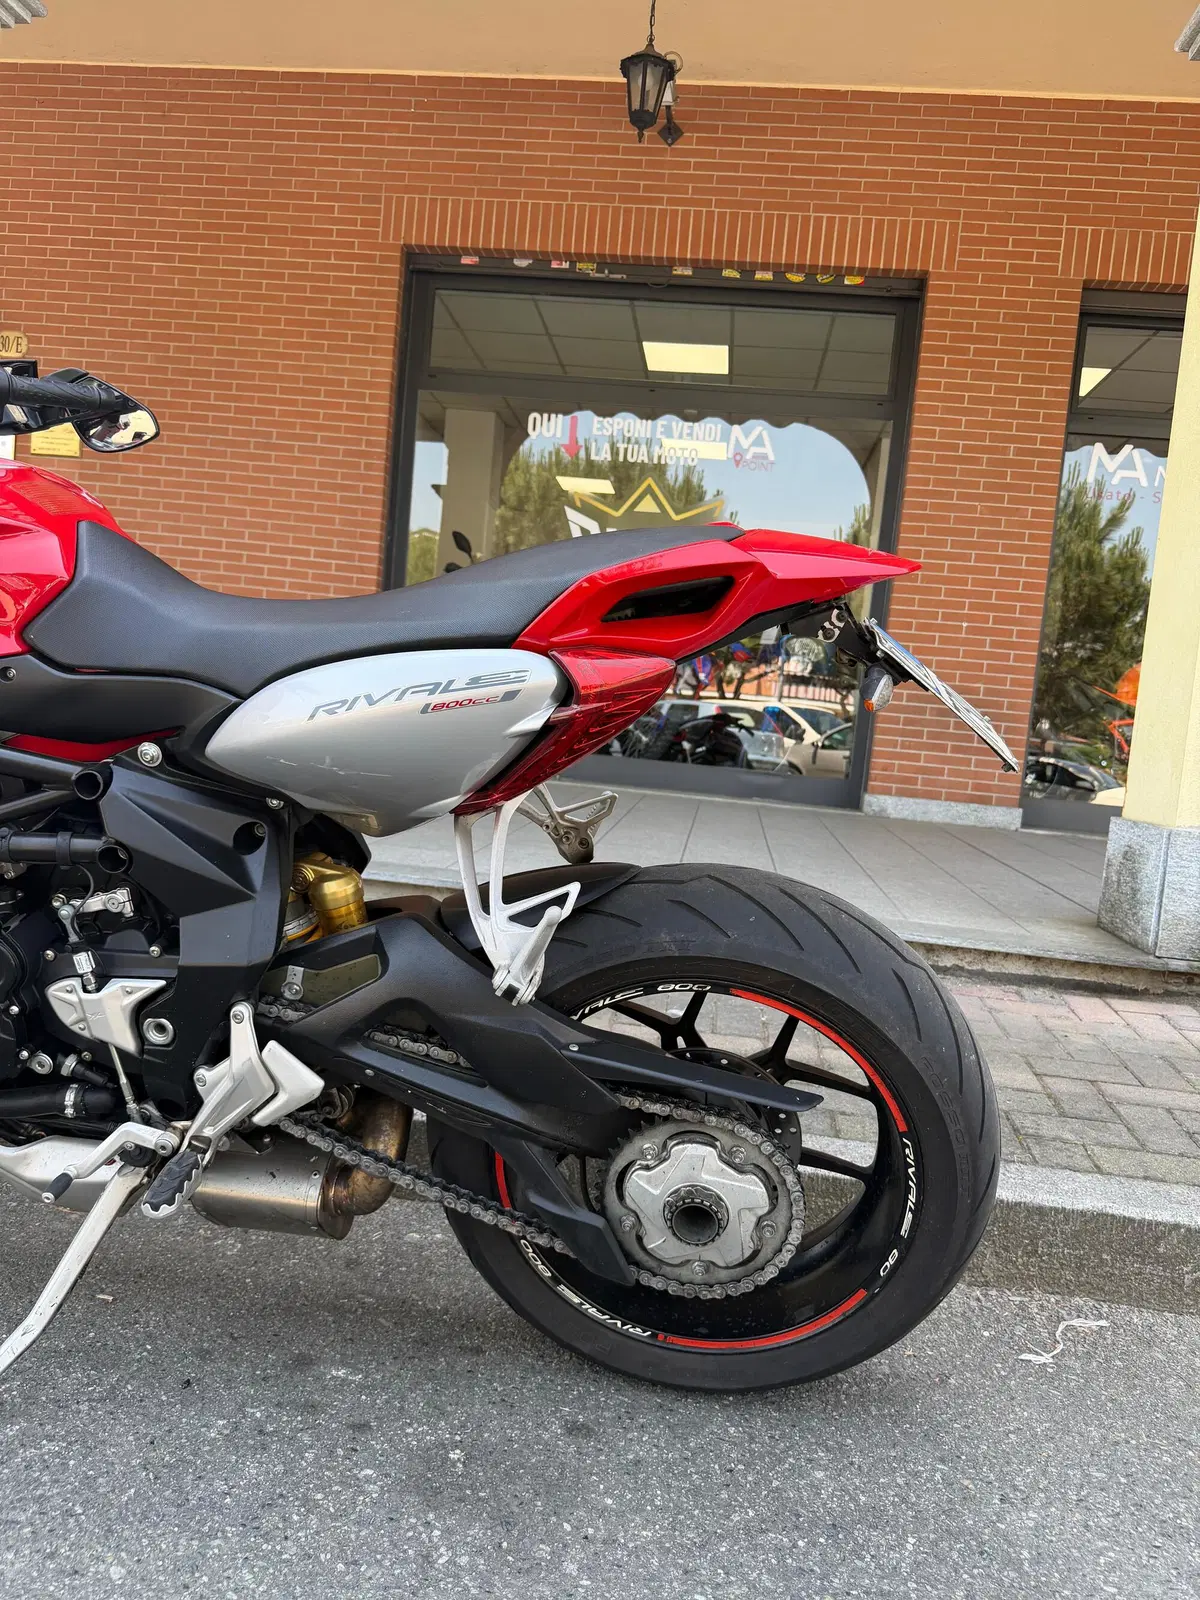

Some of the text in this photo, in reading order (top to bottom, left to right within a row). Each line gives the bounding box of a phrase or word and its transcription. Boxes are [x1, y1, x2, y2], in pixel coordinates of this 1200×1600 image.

[527, 412, 563, 439] QUI
[592, 416, 722, 442] ESPONI E VENDI
[590, 441, 699, 467] LA TUA MOTO
[742, 460, 776, 472] POINT
[307, 669, 532, 722] RIVALE
[430, 696, 499, 712] 800cc
[900, 1137, 917, 1239] RIVALE
[520, 1239, 652, 1337] RIVALE 800
